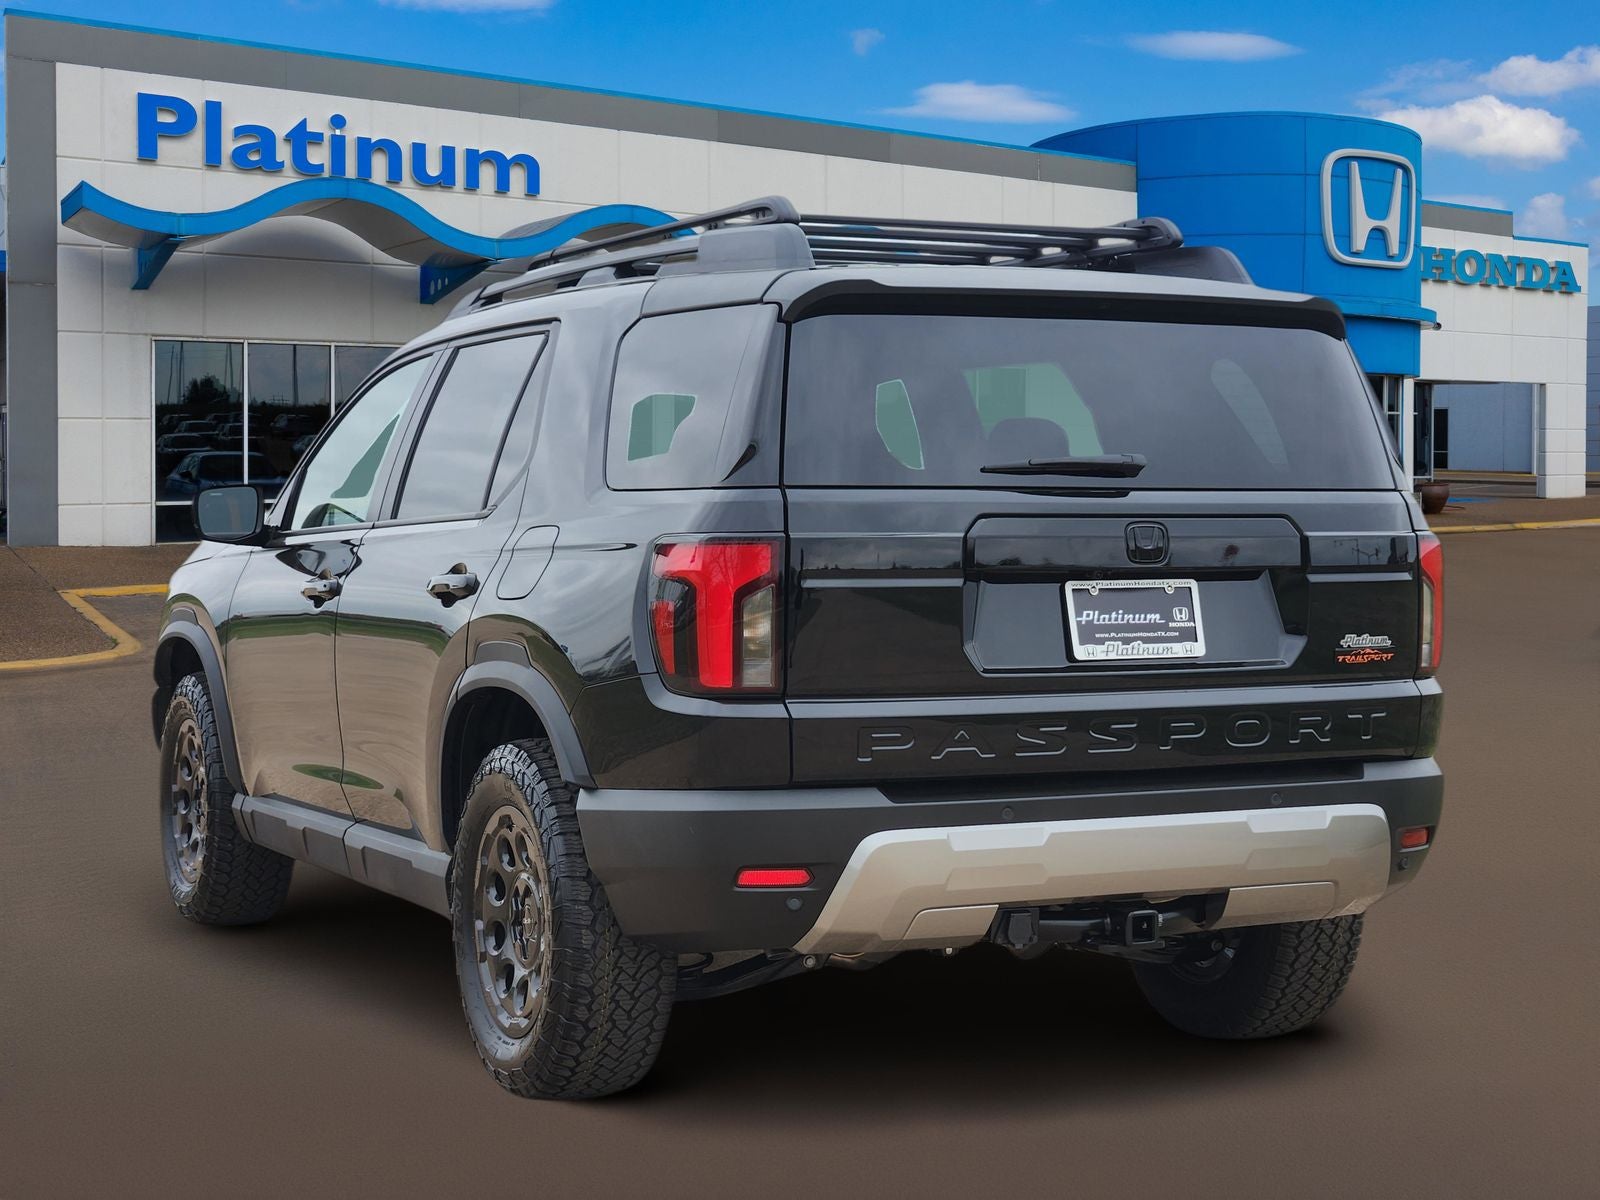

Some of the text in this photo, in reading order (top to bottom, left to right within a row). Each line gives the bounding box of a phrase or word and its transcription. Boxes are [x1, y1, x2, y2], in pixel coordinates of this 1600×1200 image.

[137, 92, 540, 196] Platinum
[1421, 246, 1581, 293] HONDA
[1075, 610, 1166, 625] Platinum
[1340, 633, 1392, 647] Platinum
[1101, 641, 1179, 657] Platinum
[1337, 653, 1394, 663] TRAILSPORT
[857, 708, 1387, 762] PASSPORT
